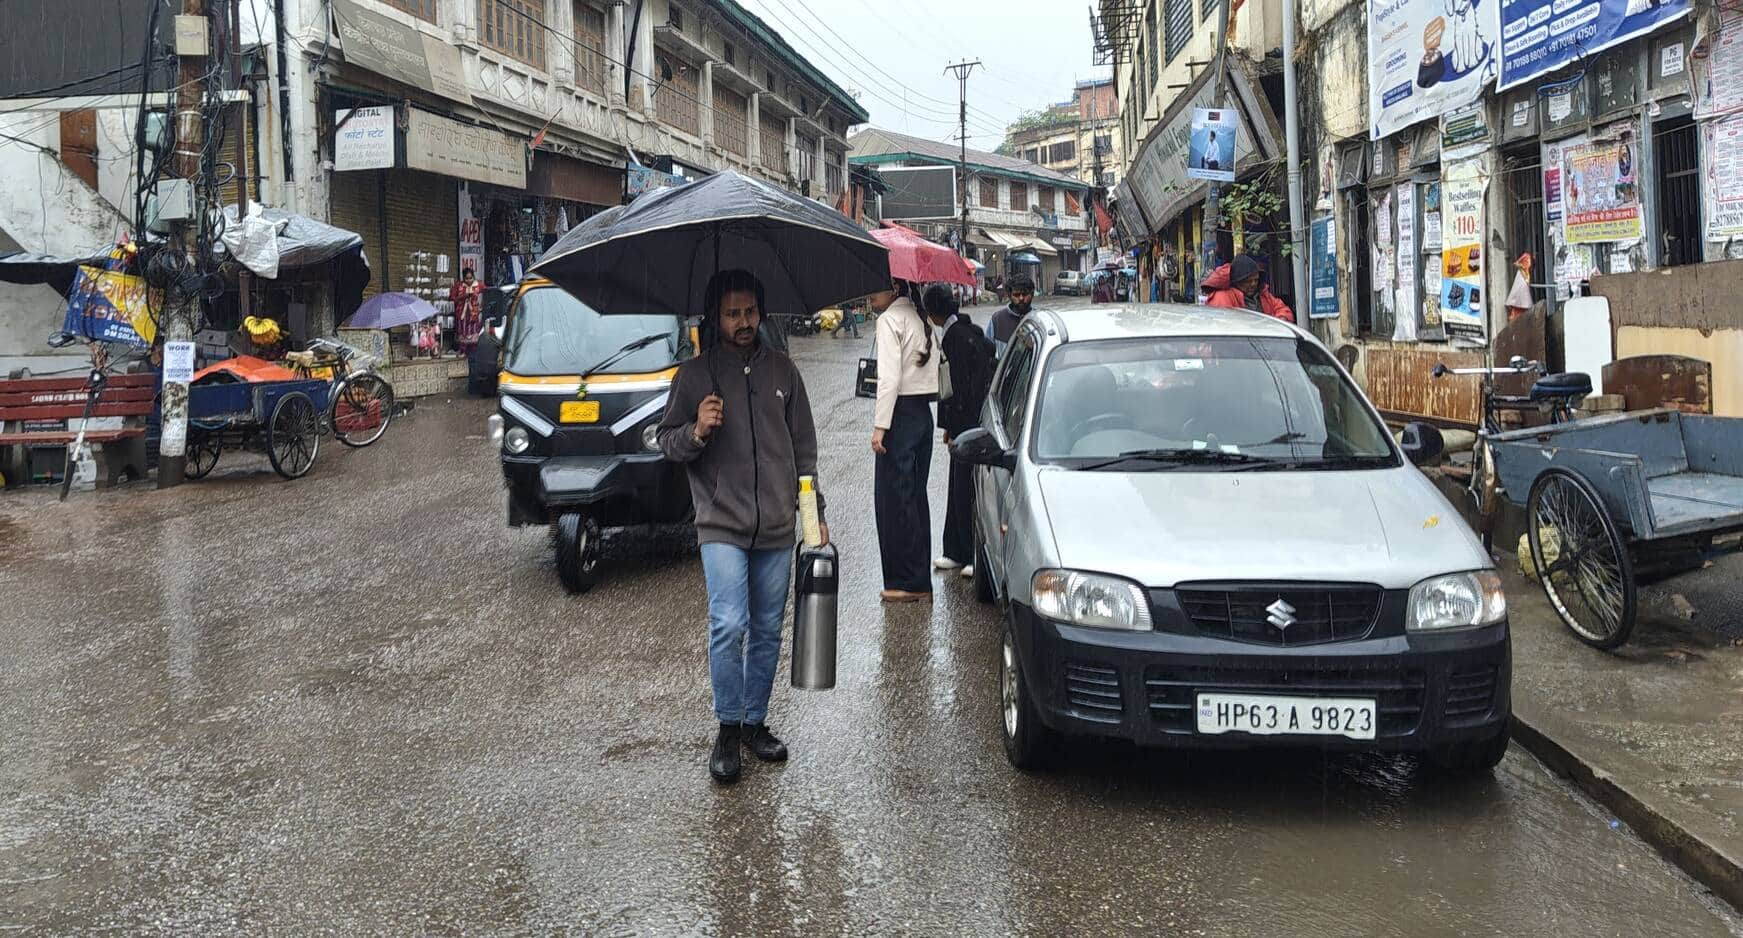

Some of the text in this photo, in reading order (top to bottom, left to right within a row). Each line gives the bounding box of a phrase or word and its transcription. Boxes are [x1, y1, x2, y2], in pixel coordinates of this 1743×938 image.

[1576, 24, 1597, 41] 47501
[1669, 46, 1678, 57] PG
[352, 108, 381, 119] IGITAL
[1448, 189, 1482, 202] Bestselling
[1453, 201, 1476, 213] Waffles
[1288, 705, 1300, 730] A
[1311, 706, 1372, 732] 9823
